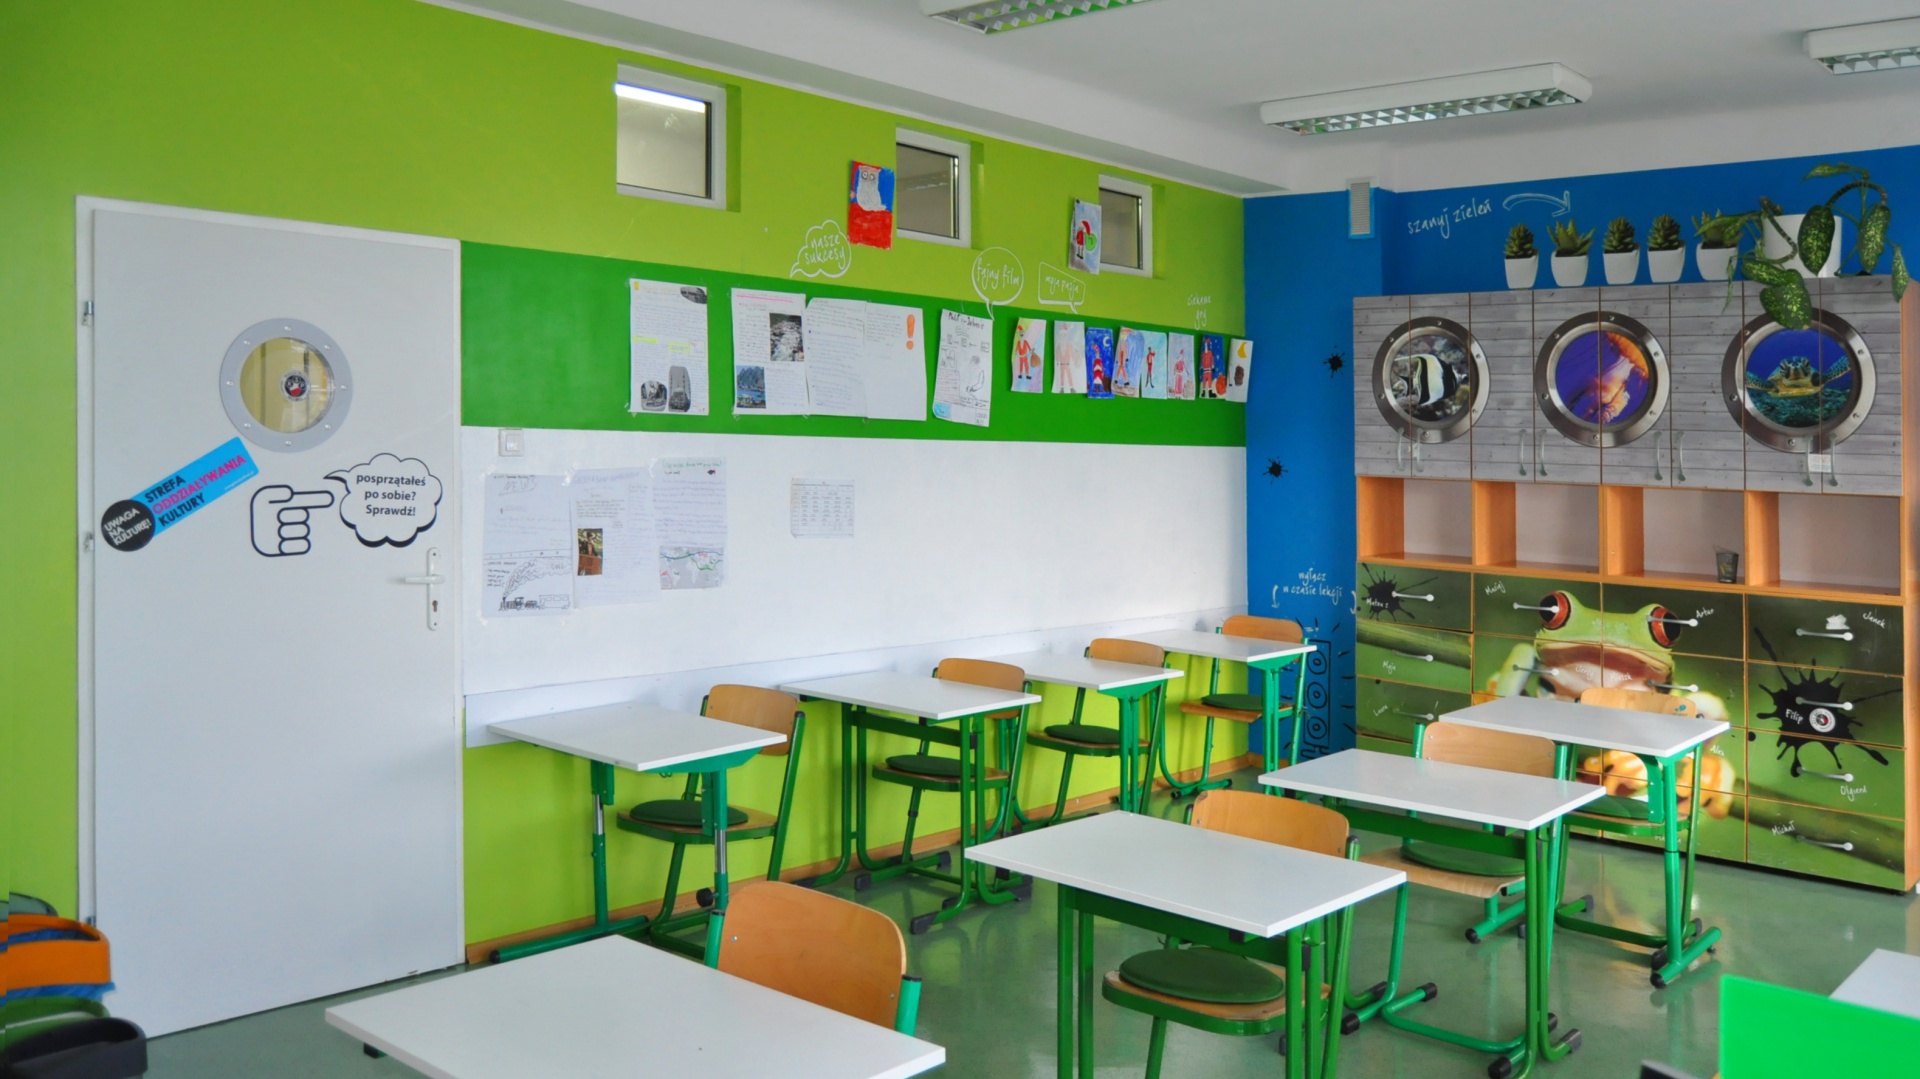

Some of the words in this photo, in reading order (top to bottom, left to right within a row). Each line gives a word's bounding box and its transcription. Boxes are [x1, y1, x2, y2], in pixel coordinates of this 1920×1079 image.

[1407, 206, 1450, 239] szanuj
[1453, 197, 1492, 223] zieleń
[810, 233, 840, 249] nasze
[804, 246, 846, 270] sukcesy
[976, 257, 1000, 290] fajny
[1002, 264, 1020, 288] film
[145, 475, 186, 503] STREFA
[152, 455, 247, 514] ODDZIAŁYWANIA
[356, 474, 426, 487] posprzątałeś
[364, 491, 379, 500] po
[381, 490, 416, 501] sobie?
[104, 508, 140, 531] UWAGA
[158, 493, 206, 526] KULTURY
[366, 504, 416, 517] Sprawdź!
[108, 526, 125, 539] NA
[112, 518, 152, 546] KULTURĘ!
